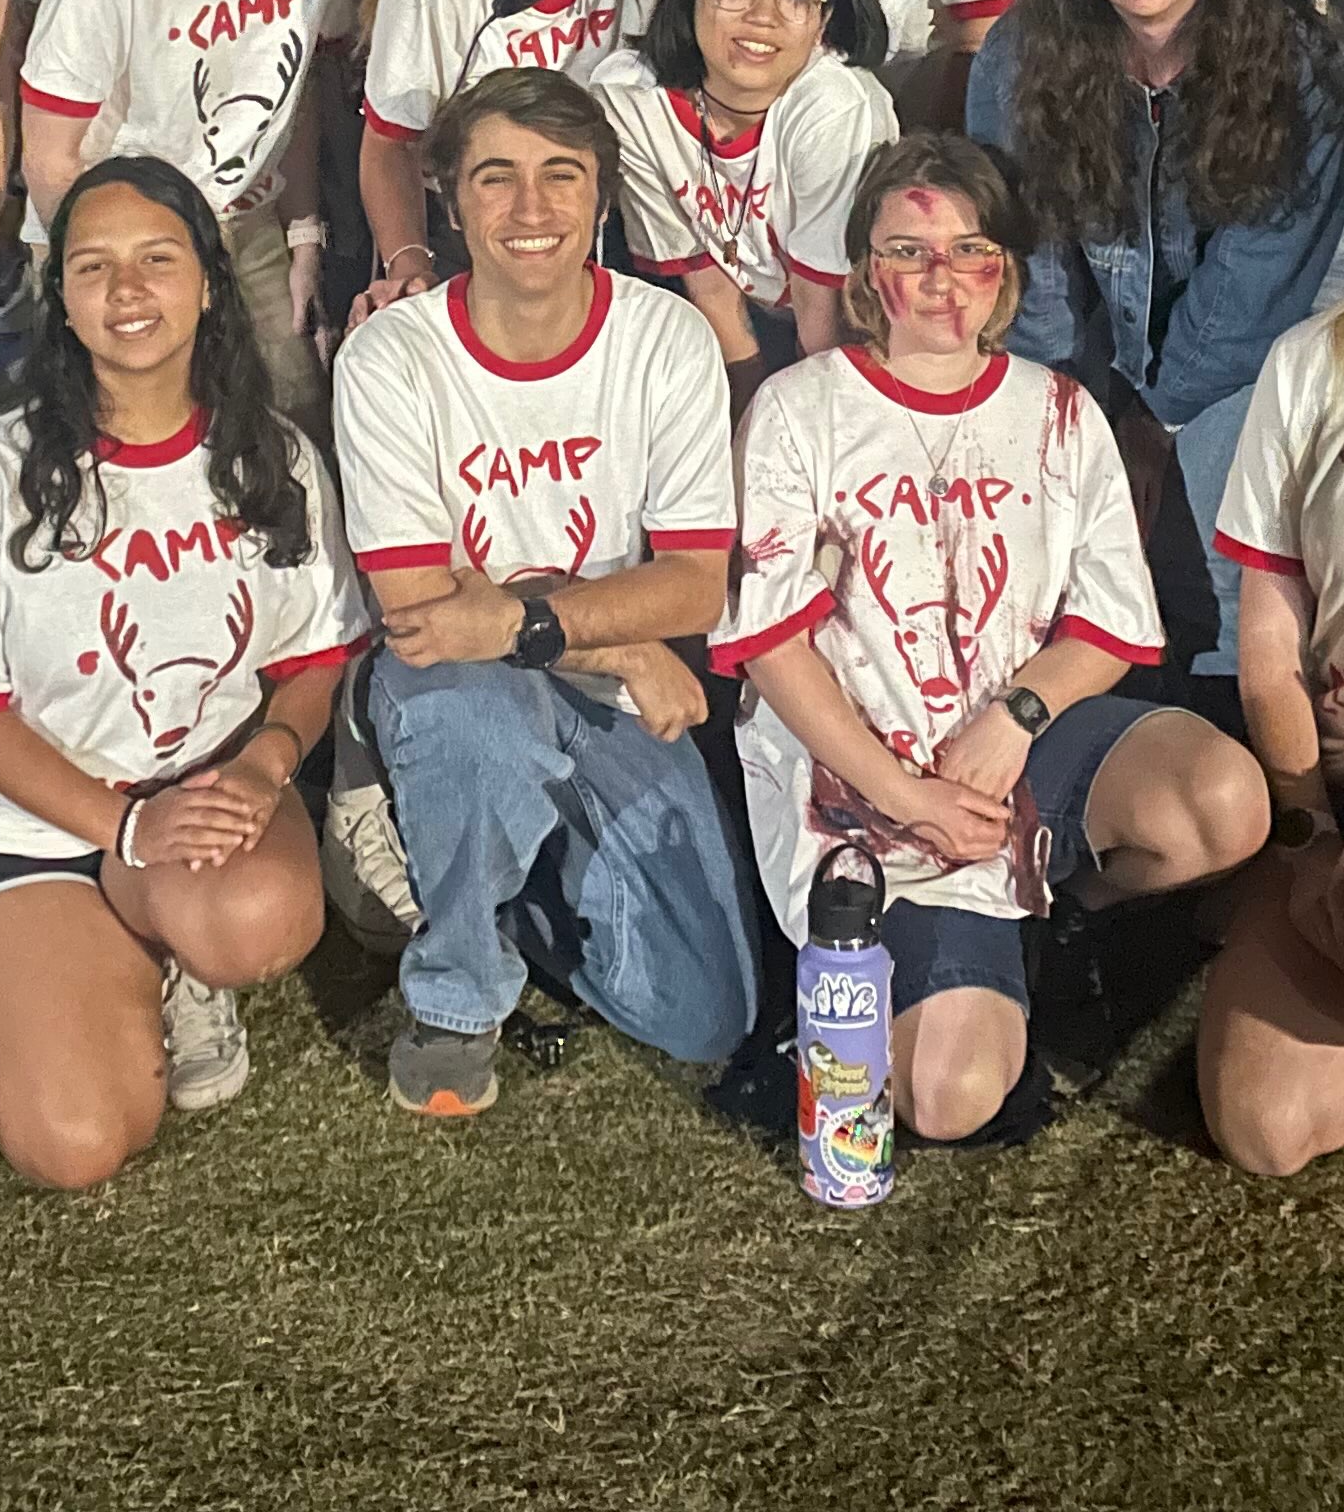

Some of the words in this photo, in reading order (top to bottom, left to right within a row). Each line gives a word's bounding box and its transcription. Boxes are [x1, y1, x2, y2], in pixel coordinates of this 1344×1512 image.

[506, 8, 616, 69] CAMP
[459, 436, 603, 498] CAMP
[856, 473, 1015, 525] CAMP
